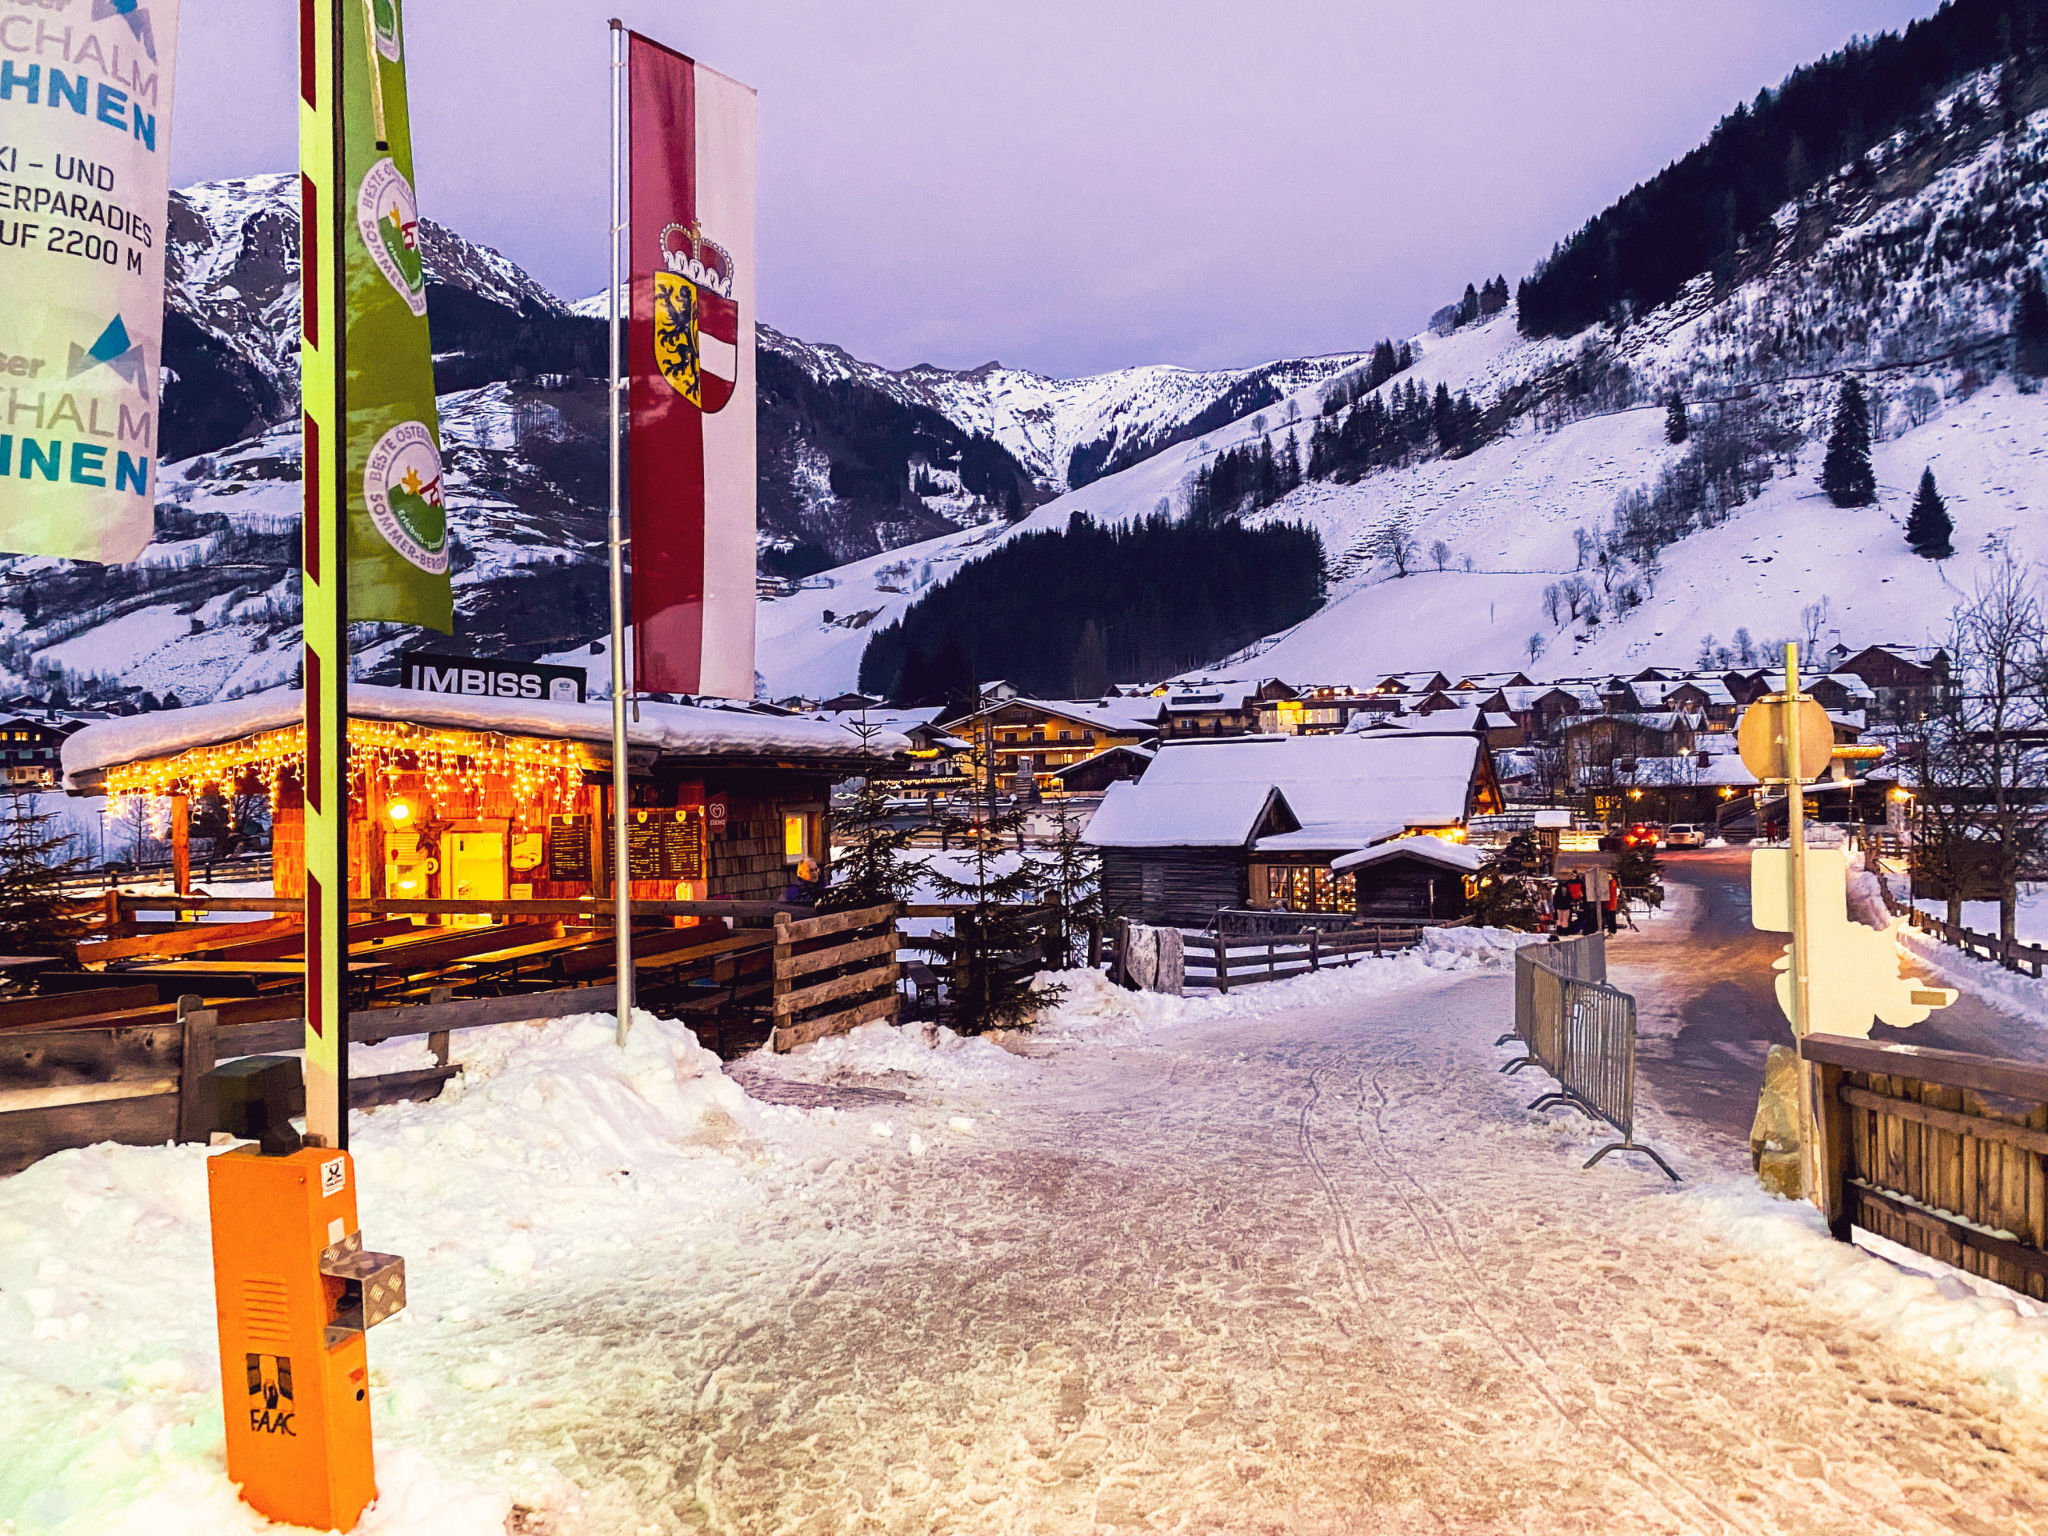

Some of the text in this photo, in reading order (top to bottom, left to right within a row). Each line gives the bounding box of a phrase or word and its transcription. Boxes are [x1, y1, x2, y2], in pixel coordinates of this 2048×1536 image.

[1, 60, 156, 152] HNEN
[55, 154, 114, 192] UND
[362, 169, 385, 209] BESTE
[47, 226, 118, 265] 2200
[127, 248, 142, 275] M
[0, 387, 149, 449] HALM
[369, 438, 396, 482] BESTE
[411, 665, 542, 698] IMBISS
[250, 1409, 297, 1437] FAAC
